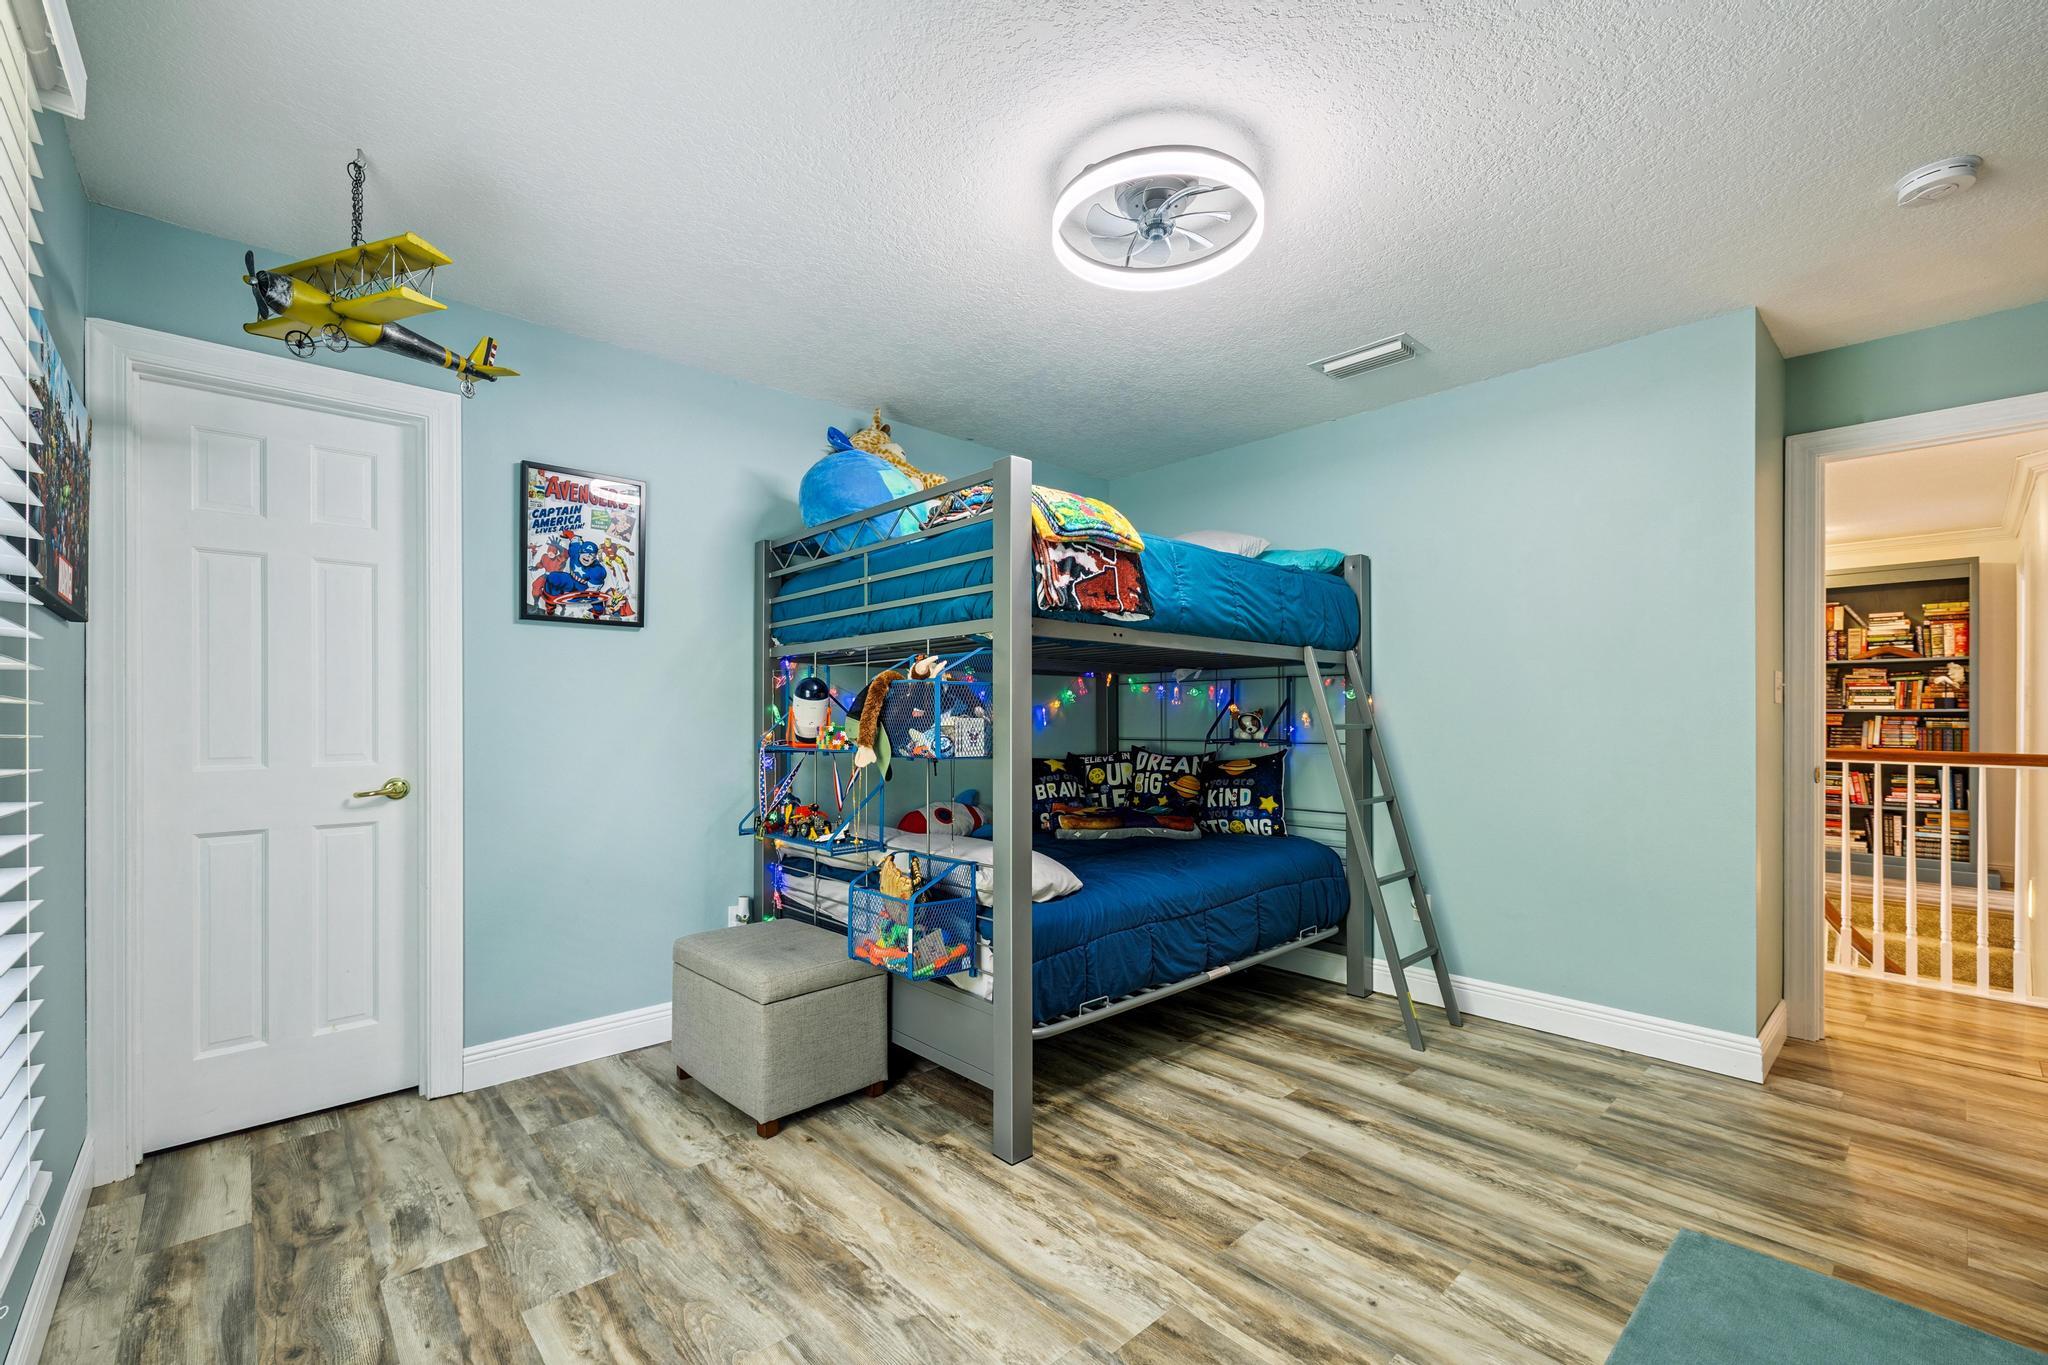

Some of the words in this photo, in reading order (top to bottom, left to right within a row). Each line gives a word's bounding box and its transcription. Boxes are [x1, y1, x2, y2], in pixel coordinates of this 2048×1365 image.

[532, 505, 583, 519] CAPTAIN
[532, 515, 582, 529] AMERICA
[535, 526, 557, 534] LIVES
[1080, 754, 1115, 765] ELIEVE
[1034, 781, 1086, 801] BRAVE
[1200, 818, 1273, 837] STRONG
